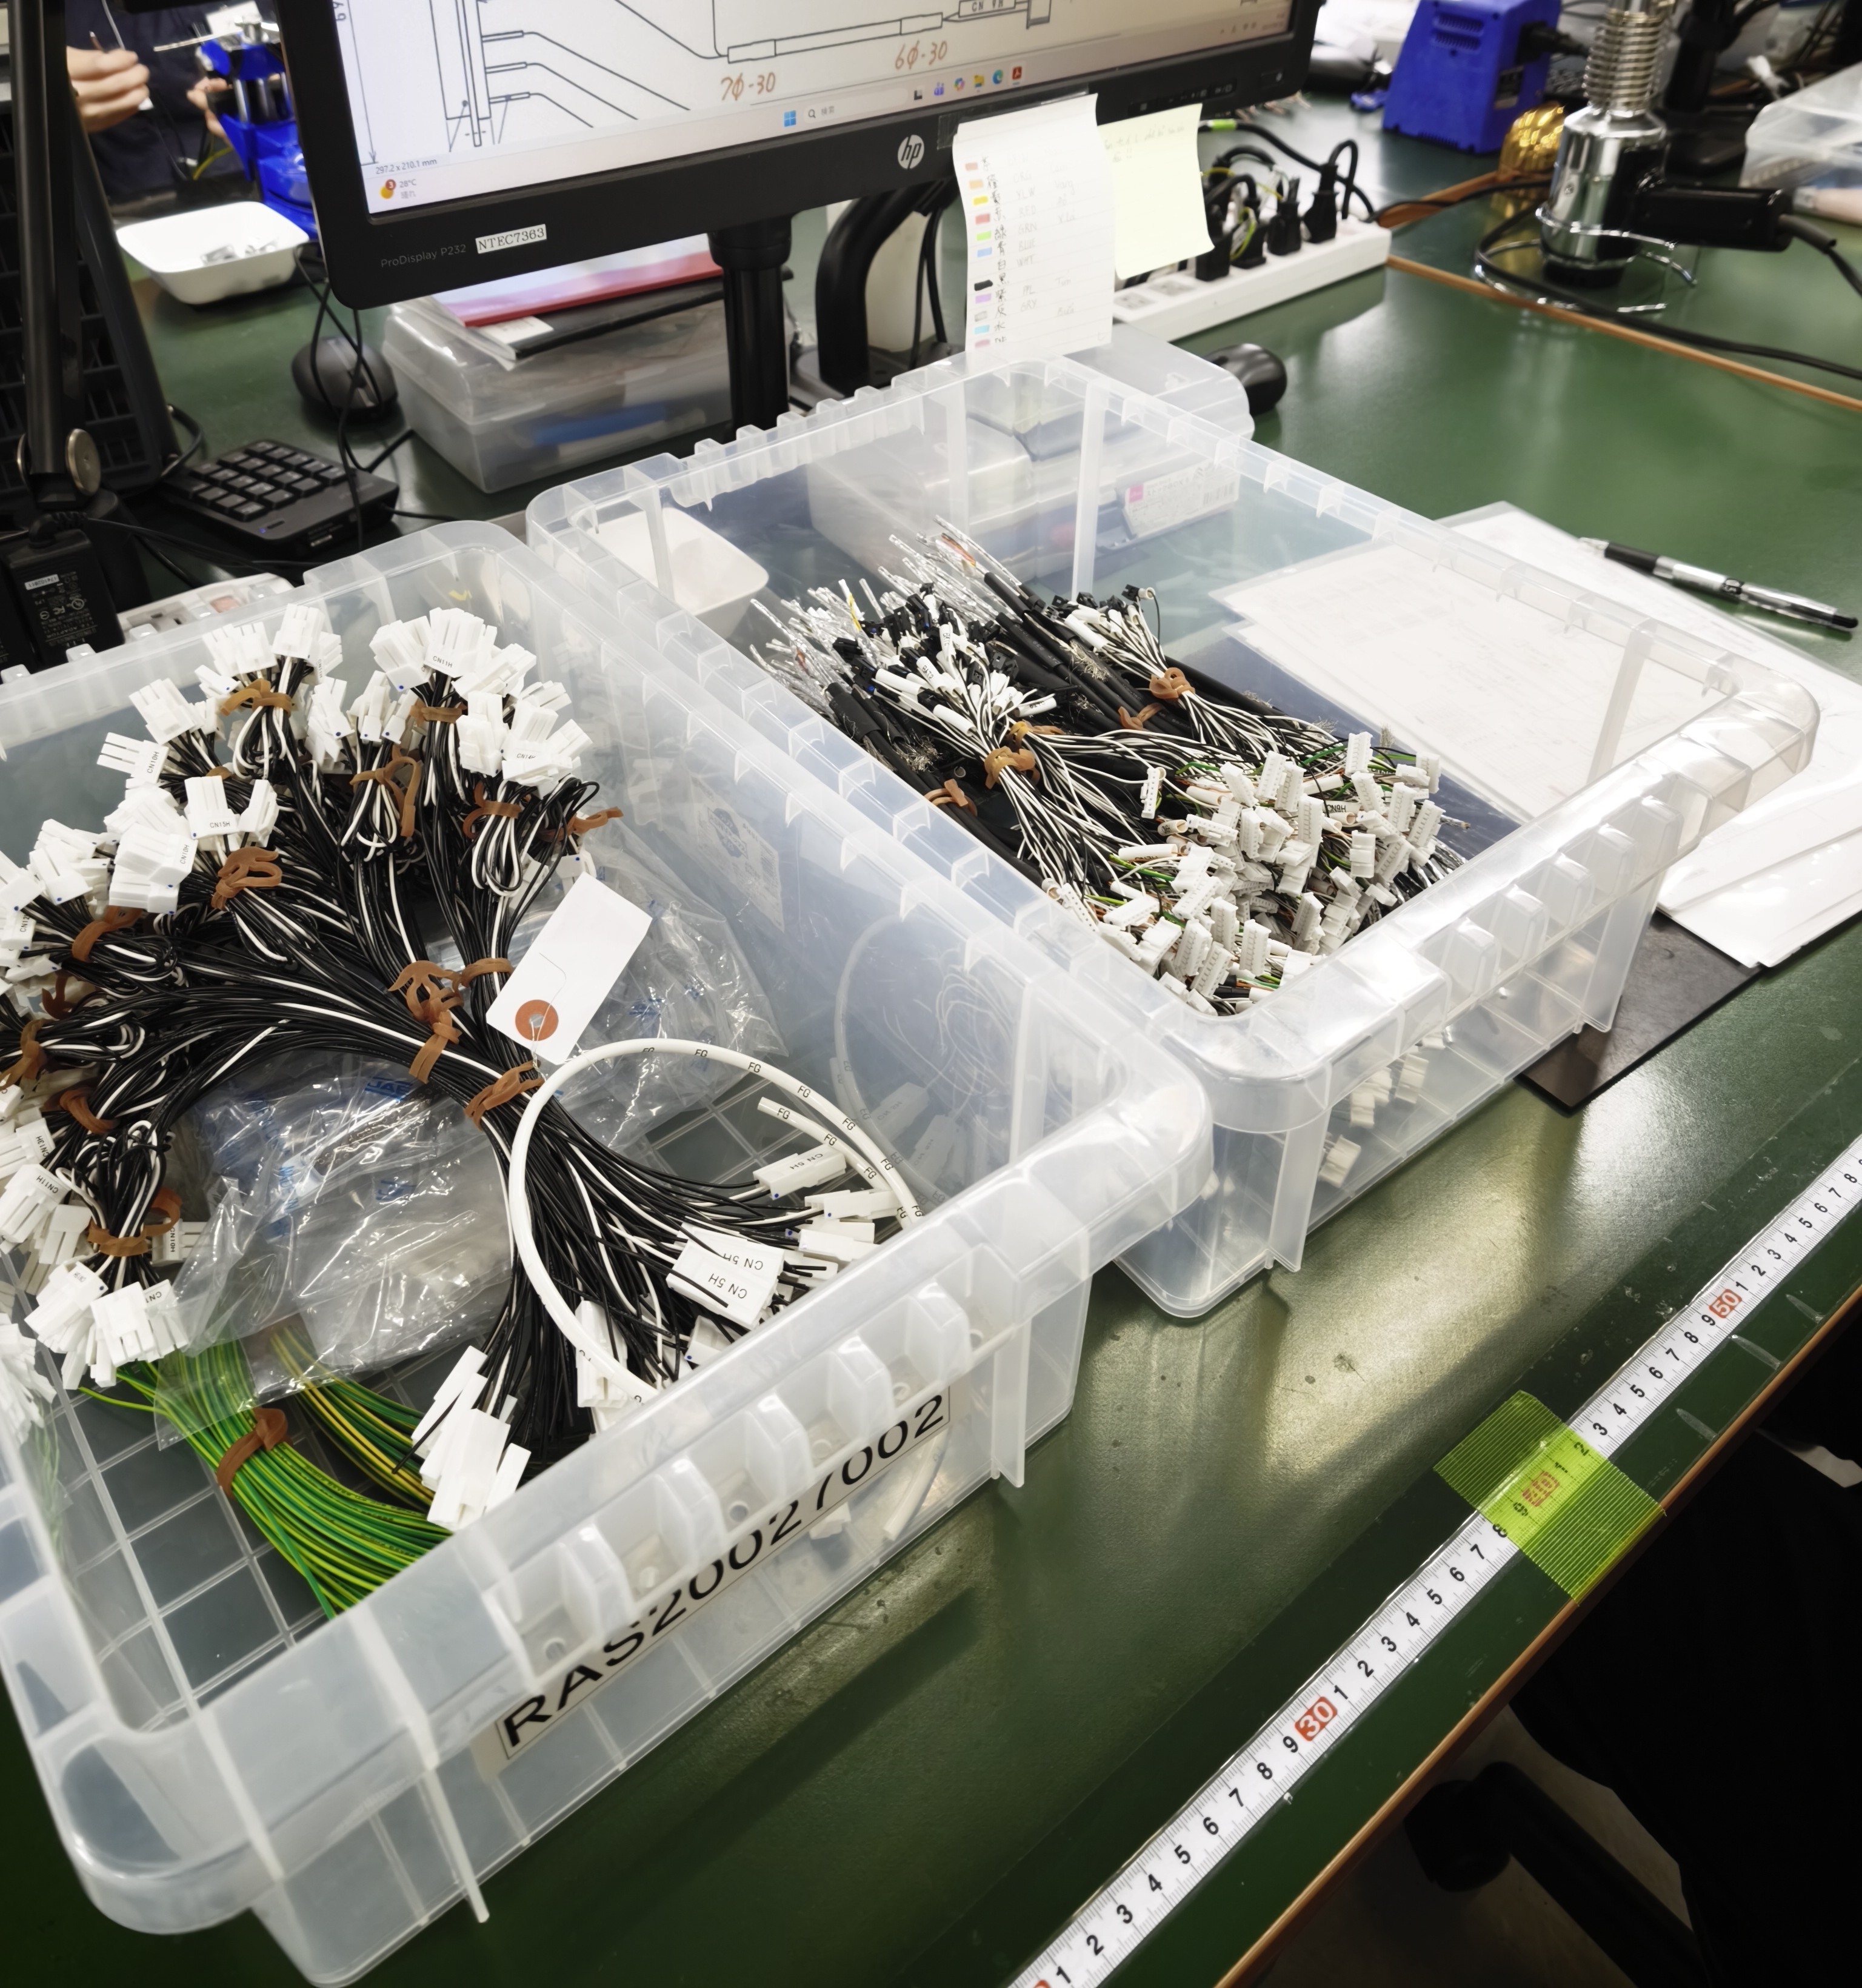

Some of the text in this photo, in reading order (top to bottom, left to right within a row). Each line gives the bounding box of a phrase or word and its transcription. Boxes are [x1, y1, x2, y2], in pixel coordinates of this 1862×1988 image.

[899, 135, 924, 169] hp
[376, 164, 395, 175] 297.2
[402, 161, 420, 170] 210.1
[478, 227, 544, 250] NTEC7363
[381, 244, 466, 267] ProDisplay P232
[433, 655, 453, 668] CN11H
[147, 751, 159, 774] CN10H
[180, 844, 190, 865] CN10H
[20, 914, 30, 932] CN12
[695, 1049, 708, 1057] FG
[748, 1062, 762, 1073] FG
[797, 1085, 811, 1098] FG
[777, 1107, 790, 1120] FG
[842, 1117, 856, 1131] FG
[36, 1135, 50, 1157] CN13H
[824, 1133, 837, 1146] FG
[807, 1153, 824, 1162] CN
[881, 1158, 894, 1171] FG
[864, 1166, 877, 1179] FG
[36, 1175, 59, 1194] CN11H
[896, 1206, 908, 1219] FG
[912, 1205, 924, 1217] FG
[744, 1258, 764, 1271] CN
[708, 1273, 747, 1299] CN 5H
[503, 1394, 944, 1747] RAS20027002
[1056, 1966, 1071, 1984] 1
[1086, 1935, 1104, 1956] 2
[1116, 1904, 1133, 1924] 3
[1148, 1873, 1163, 1892] 4
[1174, 1844, 1191, 1864] 5
[1203, 1816, 1219, 1835] 6
[1228, 1787, 1244, 1807] 7
[1256, 1762, 1273, 1780] 8
[1283, 1736, 1298, 1753] 9
[1298, 1700, 1334, 1737] 30
[1333, 1685, 1348, 1700] 1
[1357, 1660, 1374, 1678] 2
[1381, 1636, 1396, 1652] 3
[1406, 1611, 1420, 1627] 4
[1426, 1588, 1443, 1605] 5
[1449, 1567, 1465, 1582] 6
[1470, 1544, 1485, 1560] 7
[1492, 1523, 1508, 1538] 8
[1592, 1422, 1608, 1436] 3
[1613, 1403, 1627, 1416] 4
[1630, 1384, 1645, 1398] 5
[1649, 1367, 1663, 1379] 6
[1665, 1348, 1680, 1361] 7
[1684, 1331, 1699, 1344] 8
[1701, 1314, 1716, 1326] 9
[1711, 1291, 1740, 1316] 50
[1735, 1281, 1749, 1291] 1
[1751, 1265, 1766, 1276] 2
[1767, 1249, 1781, 1260] 3
[1784, 1233, 1798, 1243] 4
[1798, 1217, 1813, 1228] 5
[1814, 1202, 1828, 1213] 6
[1828, 1187, 1841, 1198] 7
[1844, 1173, 1857, 1183] 8
